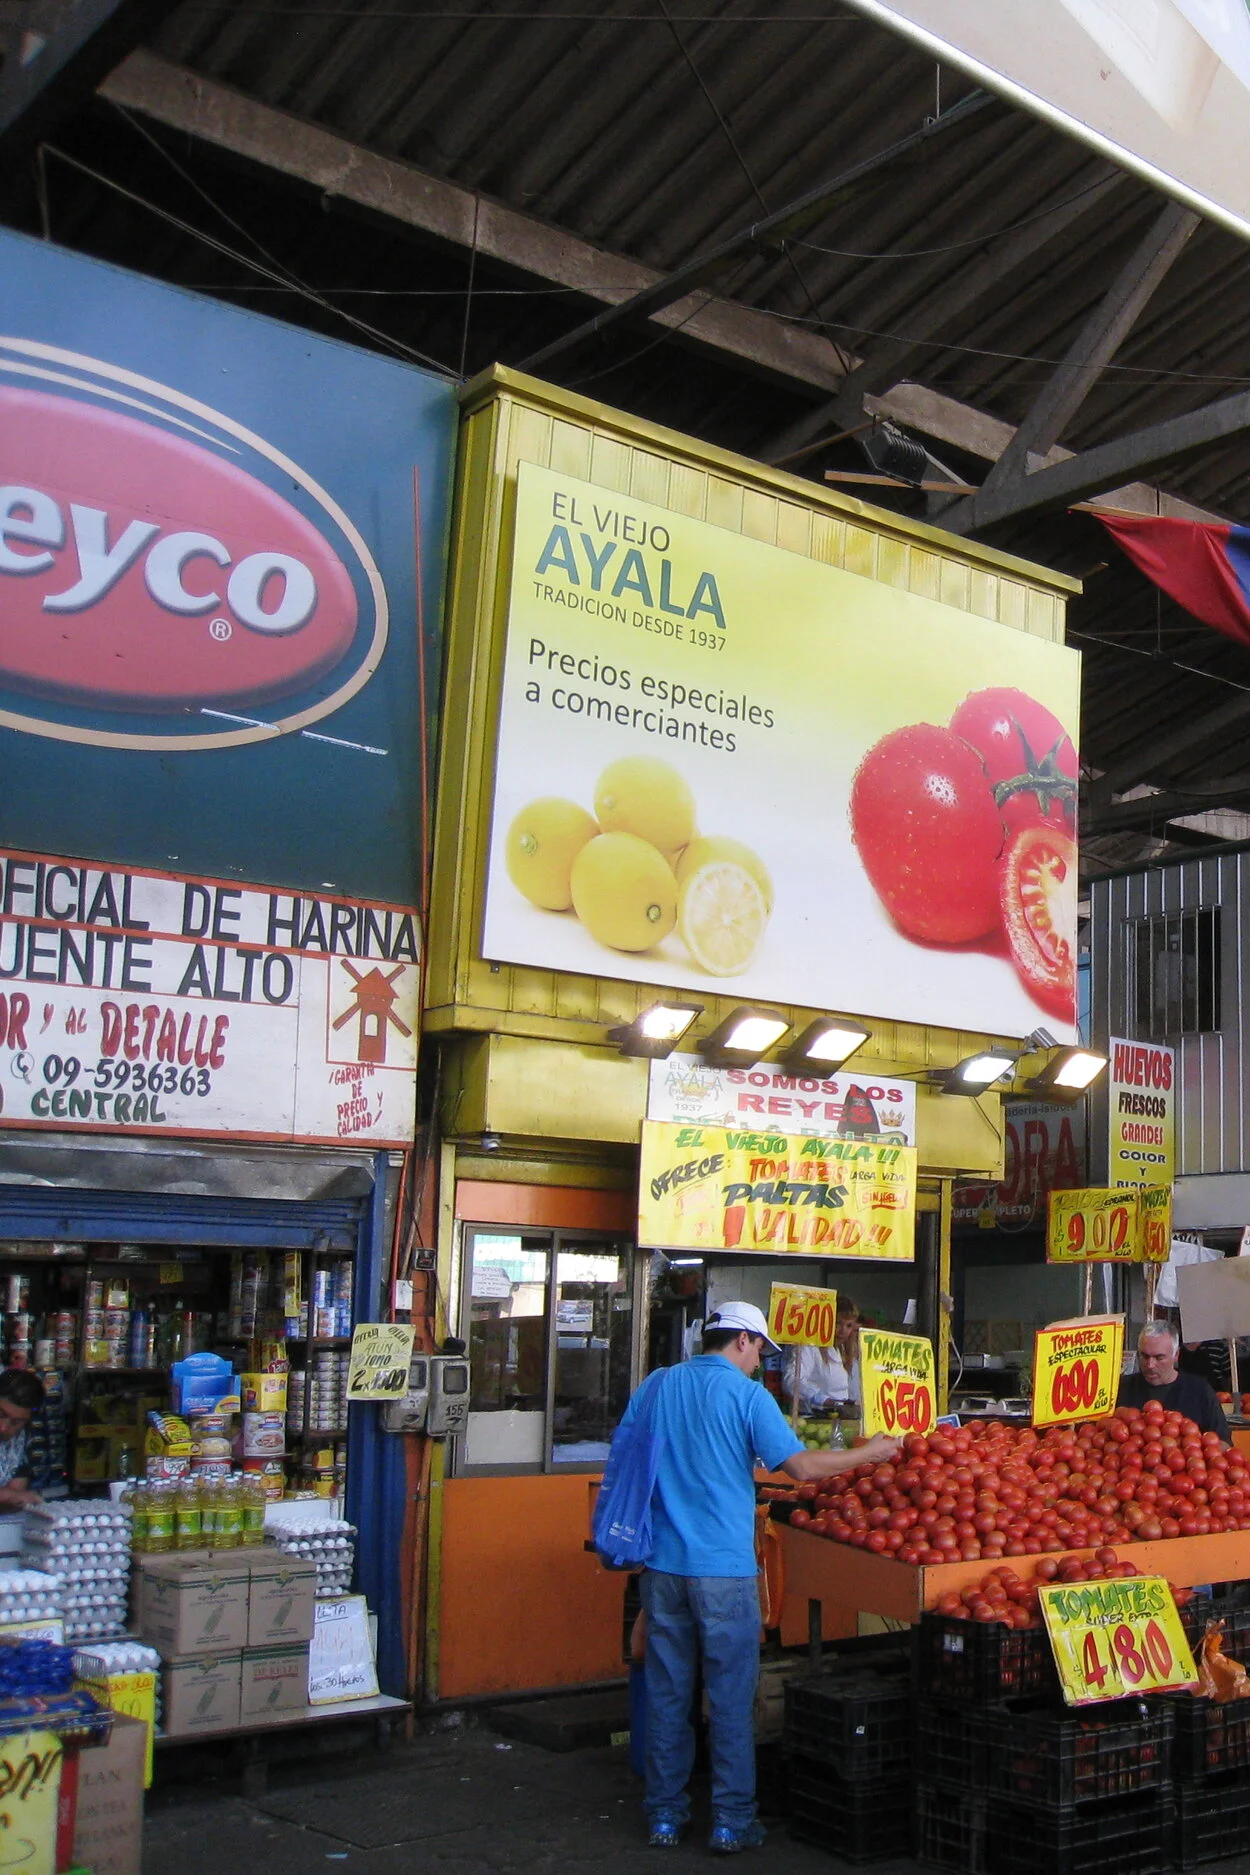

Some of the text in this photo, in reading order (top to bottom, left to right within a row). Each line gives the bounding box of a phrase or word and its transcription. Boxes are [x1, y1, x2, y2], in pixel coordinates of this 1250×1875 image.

[552, 492, 670, 551] EL VIEJO
[535, 524, 727, 629] AYALA
[533, 581, 726, 651] TRADICION DESDE 1937
[529, 638, 775, 729] Precios especiales
[525, 681, 737, 752] a comerciantes
[0, 855, 419, 963] FICIAL DE HARINA
[177, 945, 294, 1005] ALTO
[65, 1006, 88, 1035] AL
[100, 1001, 230, 1070] DETALLE
[43, 1053, 211, 1097] 09-5936363
[726, 1069, 839, 1095] SOMOS
[850, 1083, 904, 1103] LOS
[1113, 1043, 1173, 1091] HUEVOS
[31, 1087, 167, 1123] CENTRAL
[337, 1097, 368, 1120] PRECIO
[352, 1081, 362, 1099] DE
[737, 1093, 873, 1123] REYES
[1118, 1092, 1167, 1119] FRESCOS
[675, 1128, 704, 1148] EL
[726, 1131, 788, 1154] VIEJO
[800, 1138, 874, 1163] AYALA
[1121, 1122, 1164, 1145] GRANDES
[749, 1157, 848, 1185] TOMATES
[1119, 1150, 1167, 1164] COLOR
[1139, 1167, 1147, 1177] Y
[722, 1180, 849, 1209] PALTAS
[951, 1208, 978, 1218] UPER
[753, 1207, 865, 1249] CALIDAD
[1066, 1207, 1129, 1252] 900
[774, 1296, 835, 1345] 1500
[864, 1334, 932, 1372] TOMATES
[1048, 1344, 1108, 1367] ESPECTACULAR
[1050, 1329, 1104, 1353] TOMATES
[880, 1378, 932, 1433] 650
[1051, 1358, 1100, 1416] 690
[1048, 1581, 1166, 1625] TOMATES
[1086, 1612, 1125, 1626] SUPER
[1083, 1618, 1173, 1690] 480
